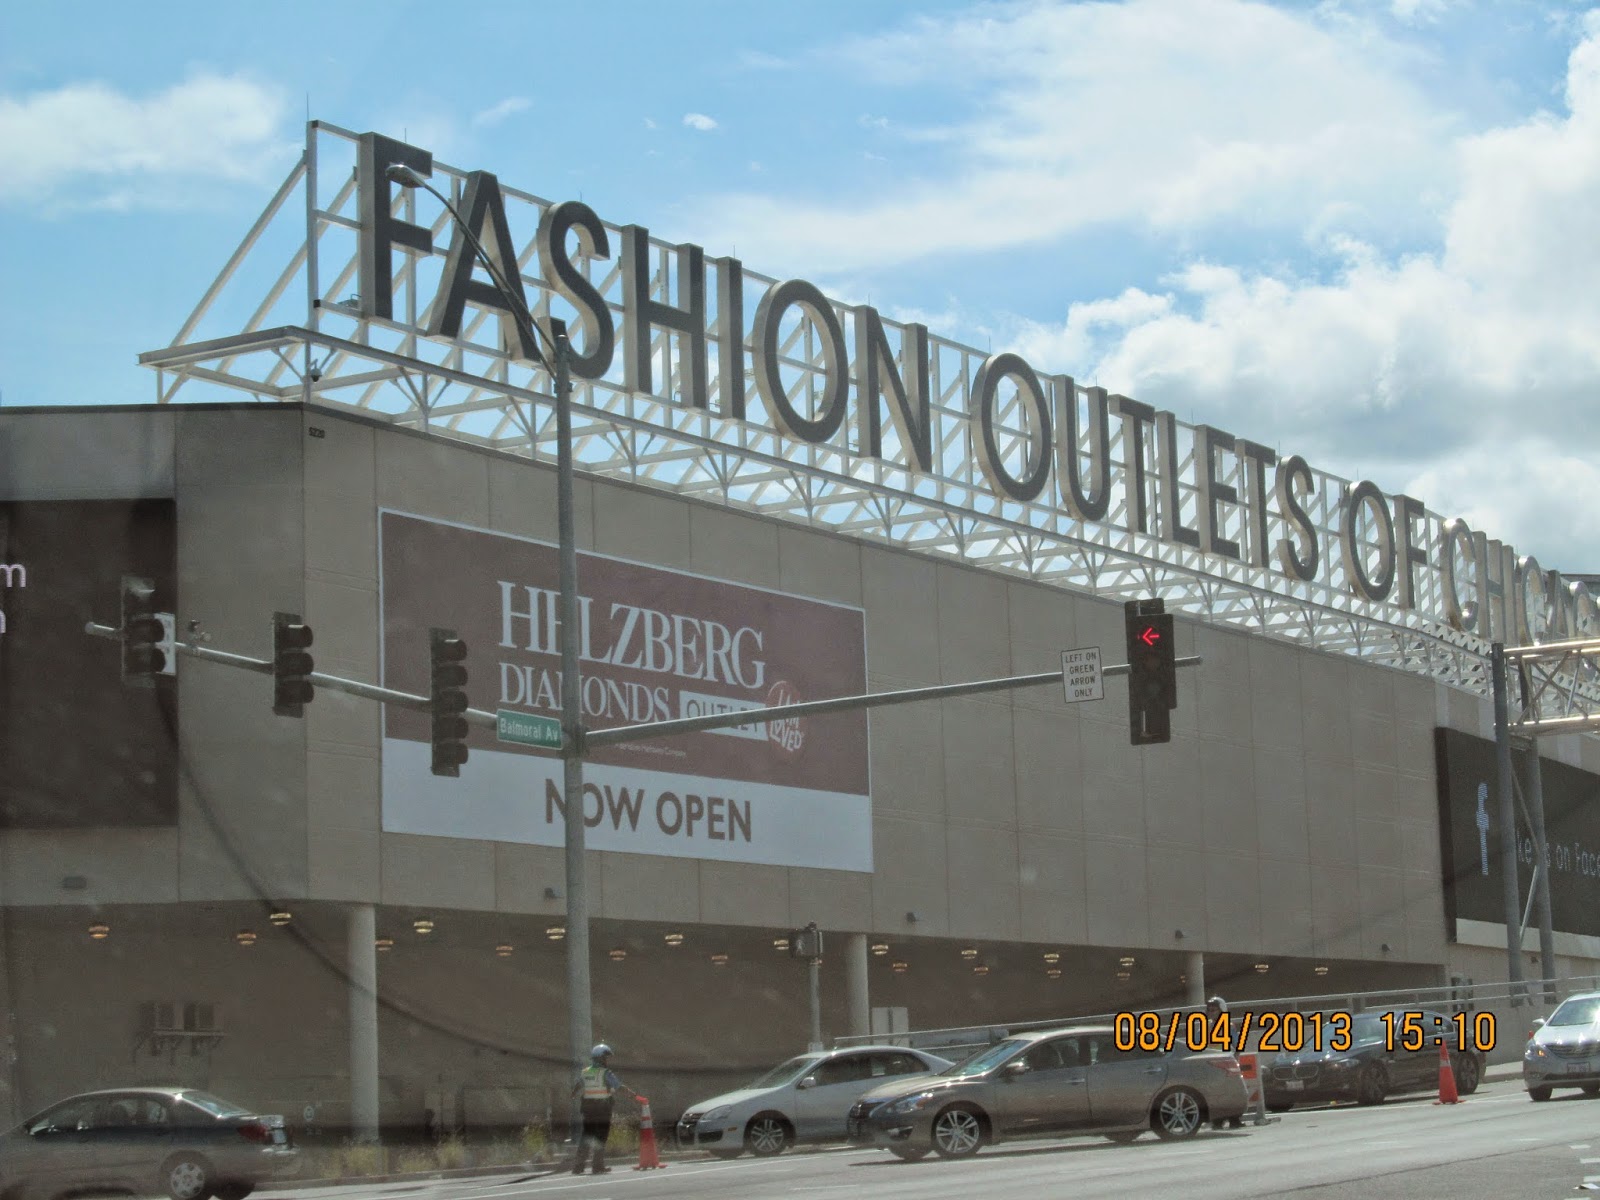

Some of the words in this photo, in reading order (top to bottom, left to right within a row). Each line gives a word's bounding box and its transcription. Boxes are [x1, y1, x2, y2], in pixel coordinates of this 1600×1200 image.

[358, 130, 932, 474] FASHION
[971, 352, 1320, 582] OUTLETS
[1342, 480, 1427, 609] OF
[497, 580, 766, 690] HELZBERG
[1065, 653, 1083, 663] LEFT
[1086, 652, 1097, 661] ON
[1069, 664, 1095, 675] GREEN
[499, 662, 671, 723] DIAONDS
[1070, 676, 1096, 686] ARROW
[1074, 688, 1093, 698] ONLY
[500, 717, 542, 740] Balmoral
[546, 725, 558, 741] Av
[545, 778, 645, 832] NOW
[656, 791, 752, 843] OPEN
